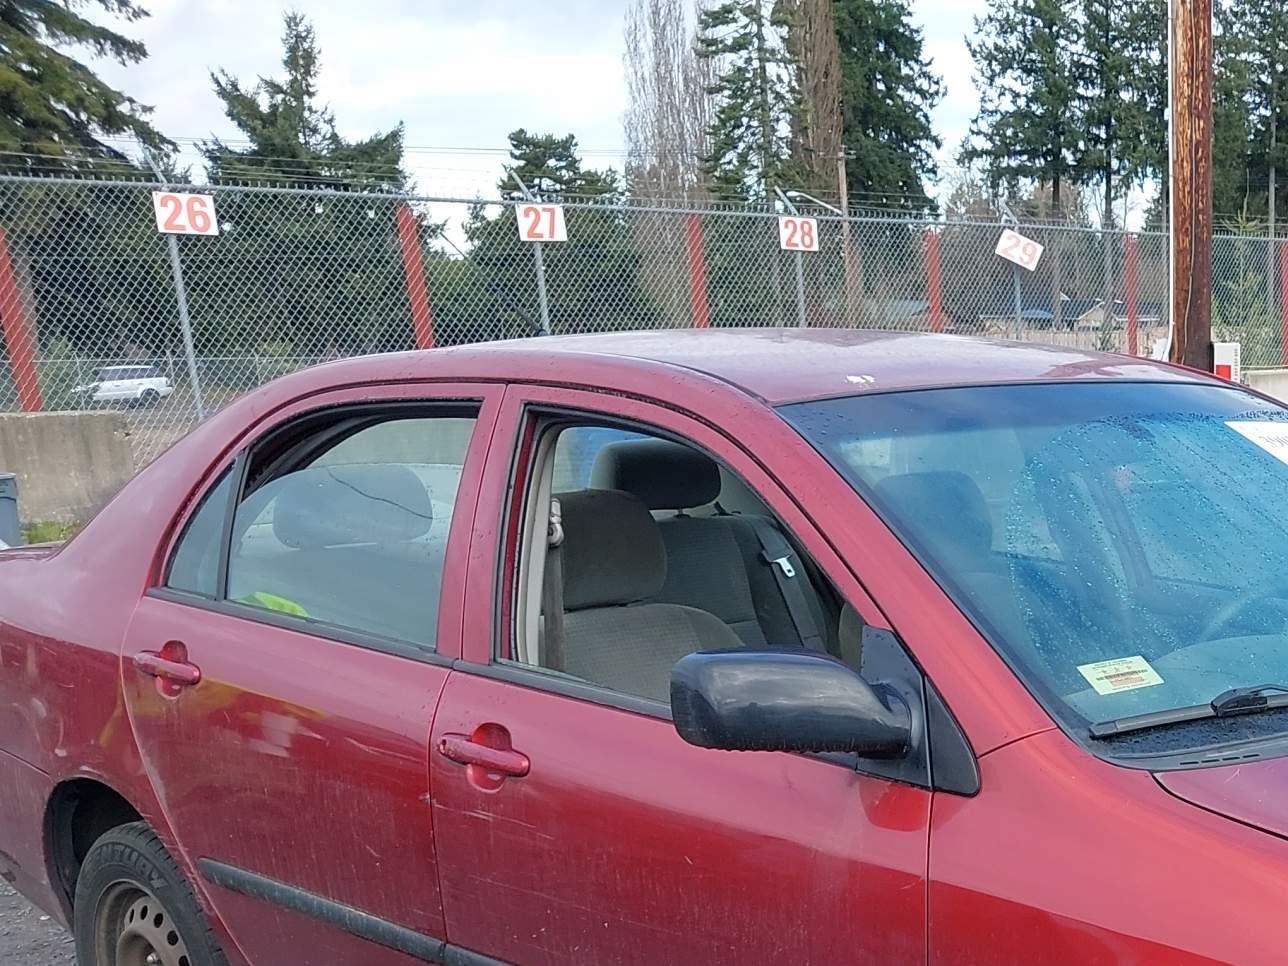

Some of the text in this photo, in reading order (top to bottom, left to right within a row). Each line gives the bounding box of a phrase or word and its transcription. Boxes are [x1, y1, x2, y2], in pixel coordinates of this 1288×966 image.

[160, 194, 211, 232] 26
[523, 207, 555, 239] 27
[784, 219, 814, 248] 28
[1001, 233, 1038, 265] 29
